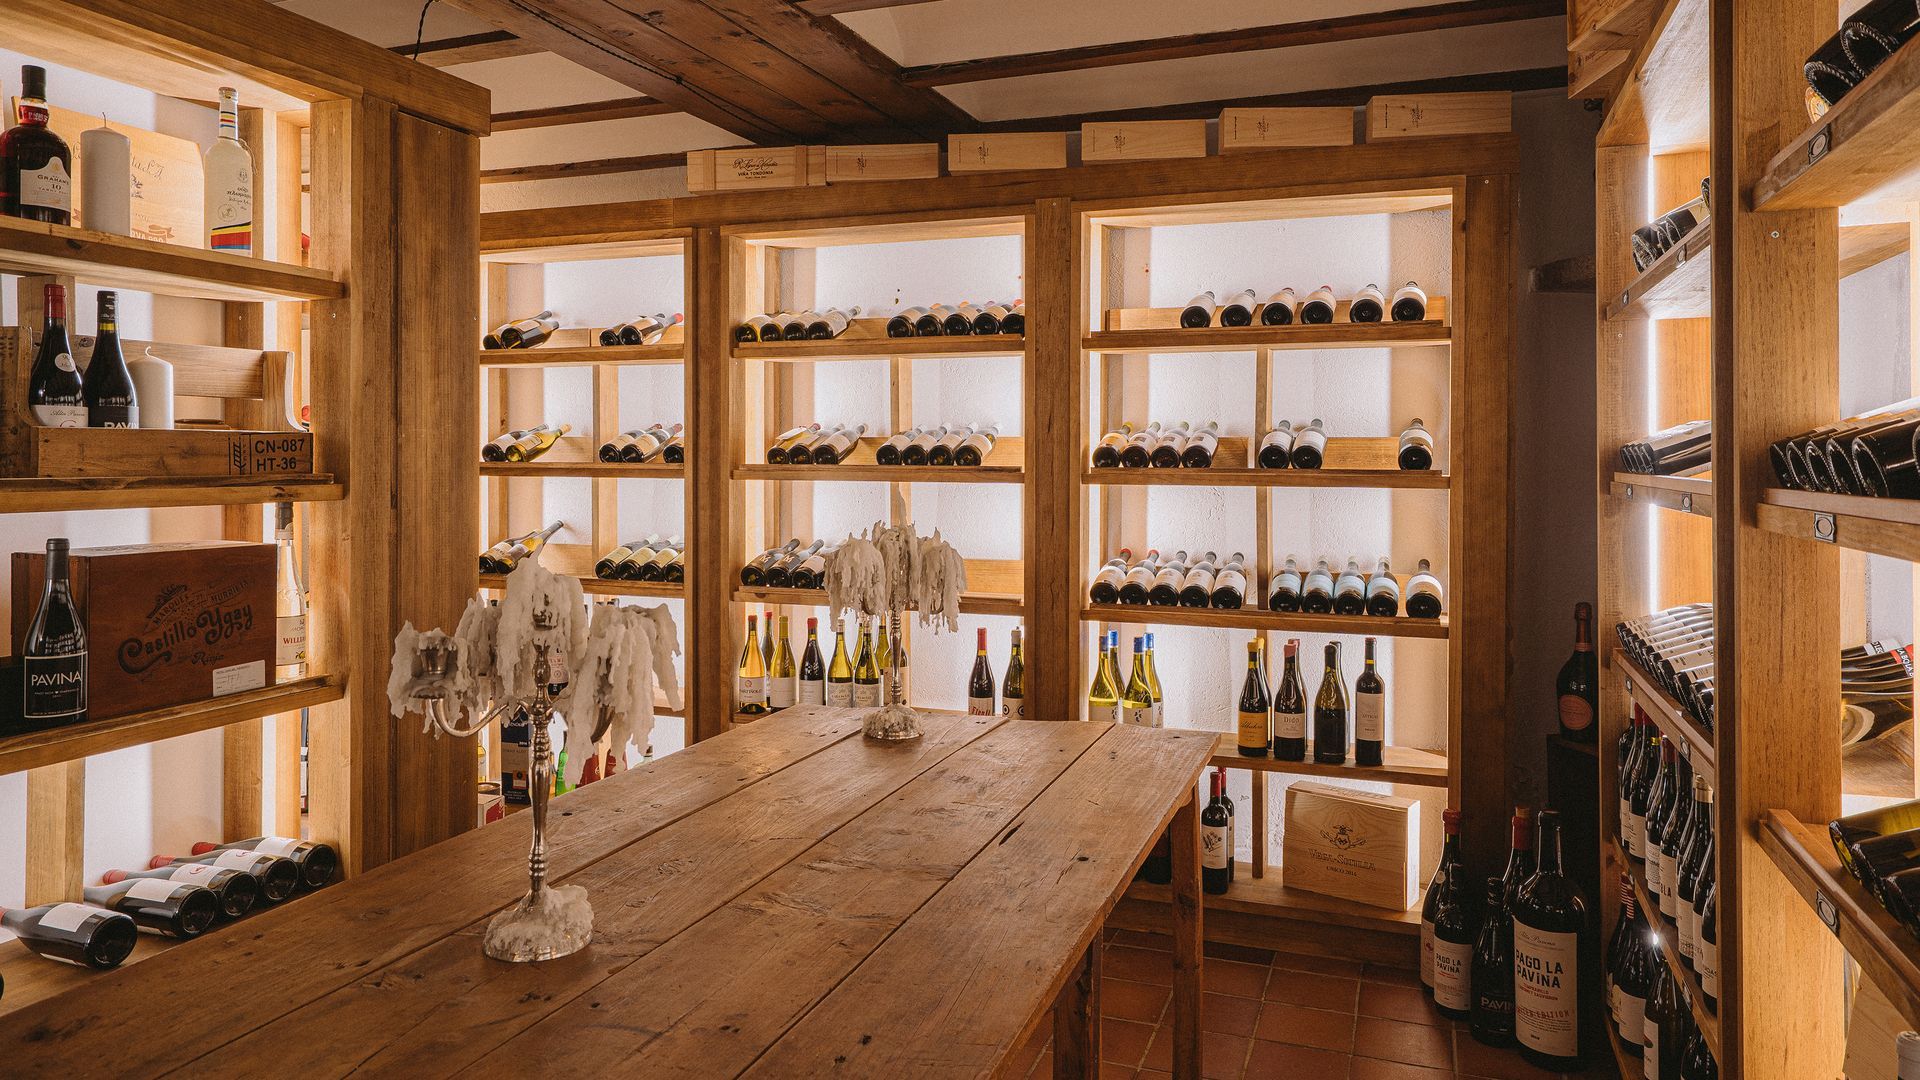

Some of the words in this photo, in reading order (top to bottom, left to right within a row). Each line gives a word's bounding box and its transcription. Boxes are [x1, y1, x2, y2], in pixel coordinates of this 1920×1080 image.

[255, 439, 305, 454] CN-087
[257, 457, 297, 471] HT-36
[118, 621, 197, 675] Castillo
[196, 604, 254, 645] Ygay
[192, 651, 225, 666] Rioja
[31, 671, 82, 686] PAVINA
[1436, 952, 1451, 966] PAGO
[1452, 959, 1462, 967] LA
[1515, 948, 1541, 971] PAGO
[1546, 961, 1564, 975] LA
